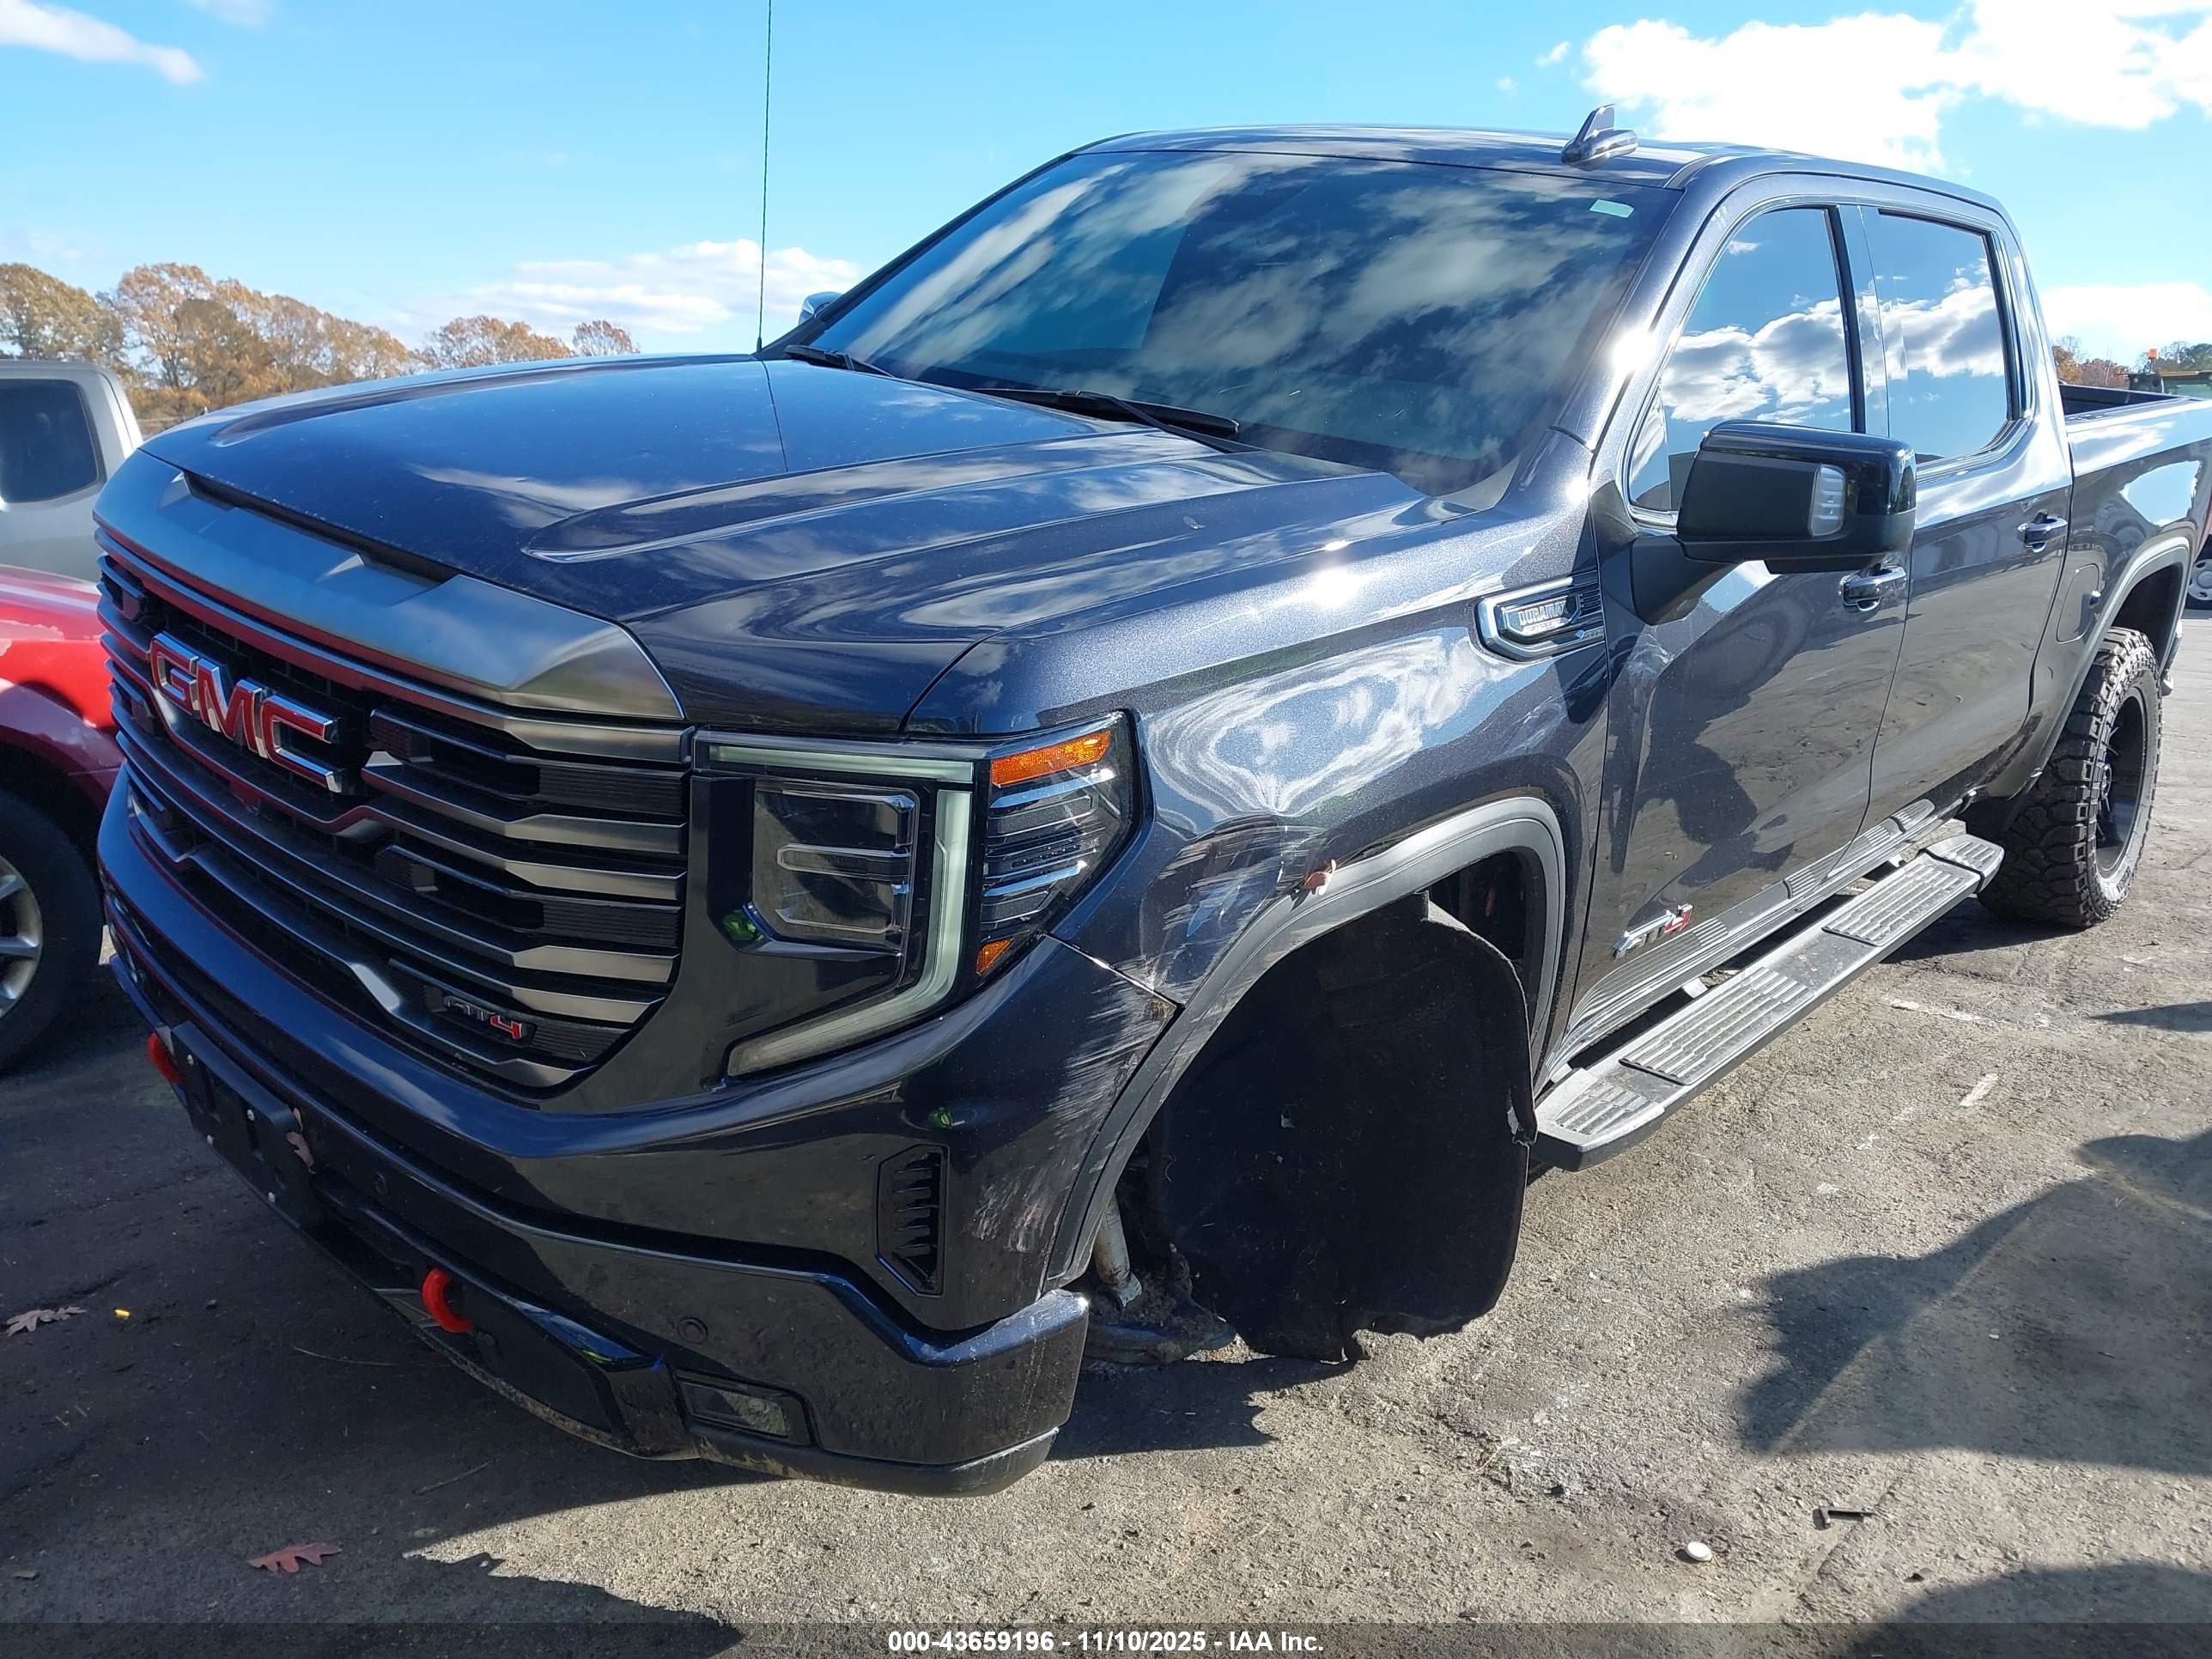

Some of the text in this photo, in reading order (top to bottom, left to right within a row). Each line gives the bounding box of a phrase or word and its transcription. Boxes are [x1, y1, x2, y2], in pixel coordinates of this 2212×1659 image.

[150, 631, 342, 793] GMC
[1613, 903, 1693, 959] AT4
[443, 995, 523, 1041] AT4
